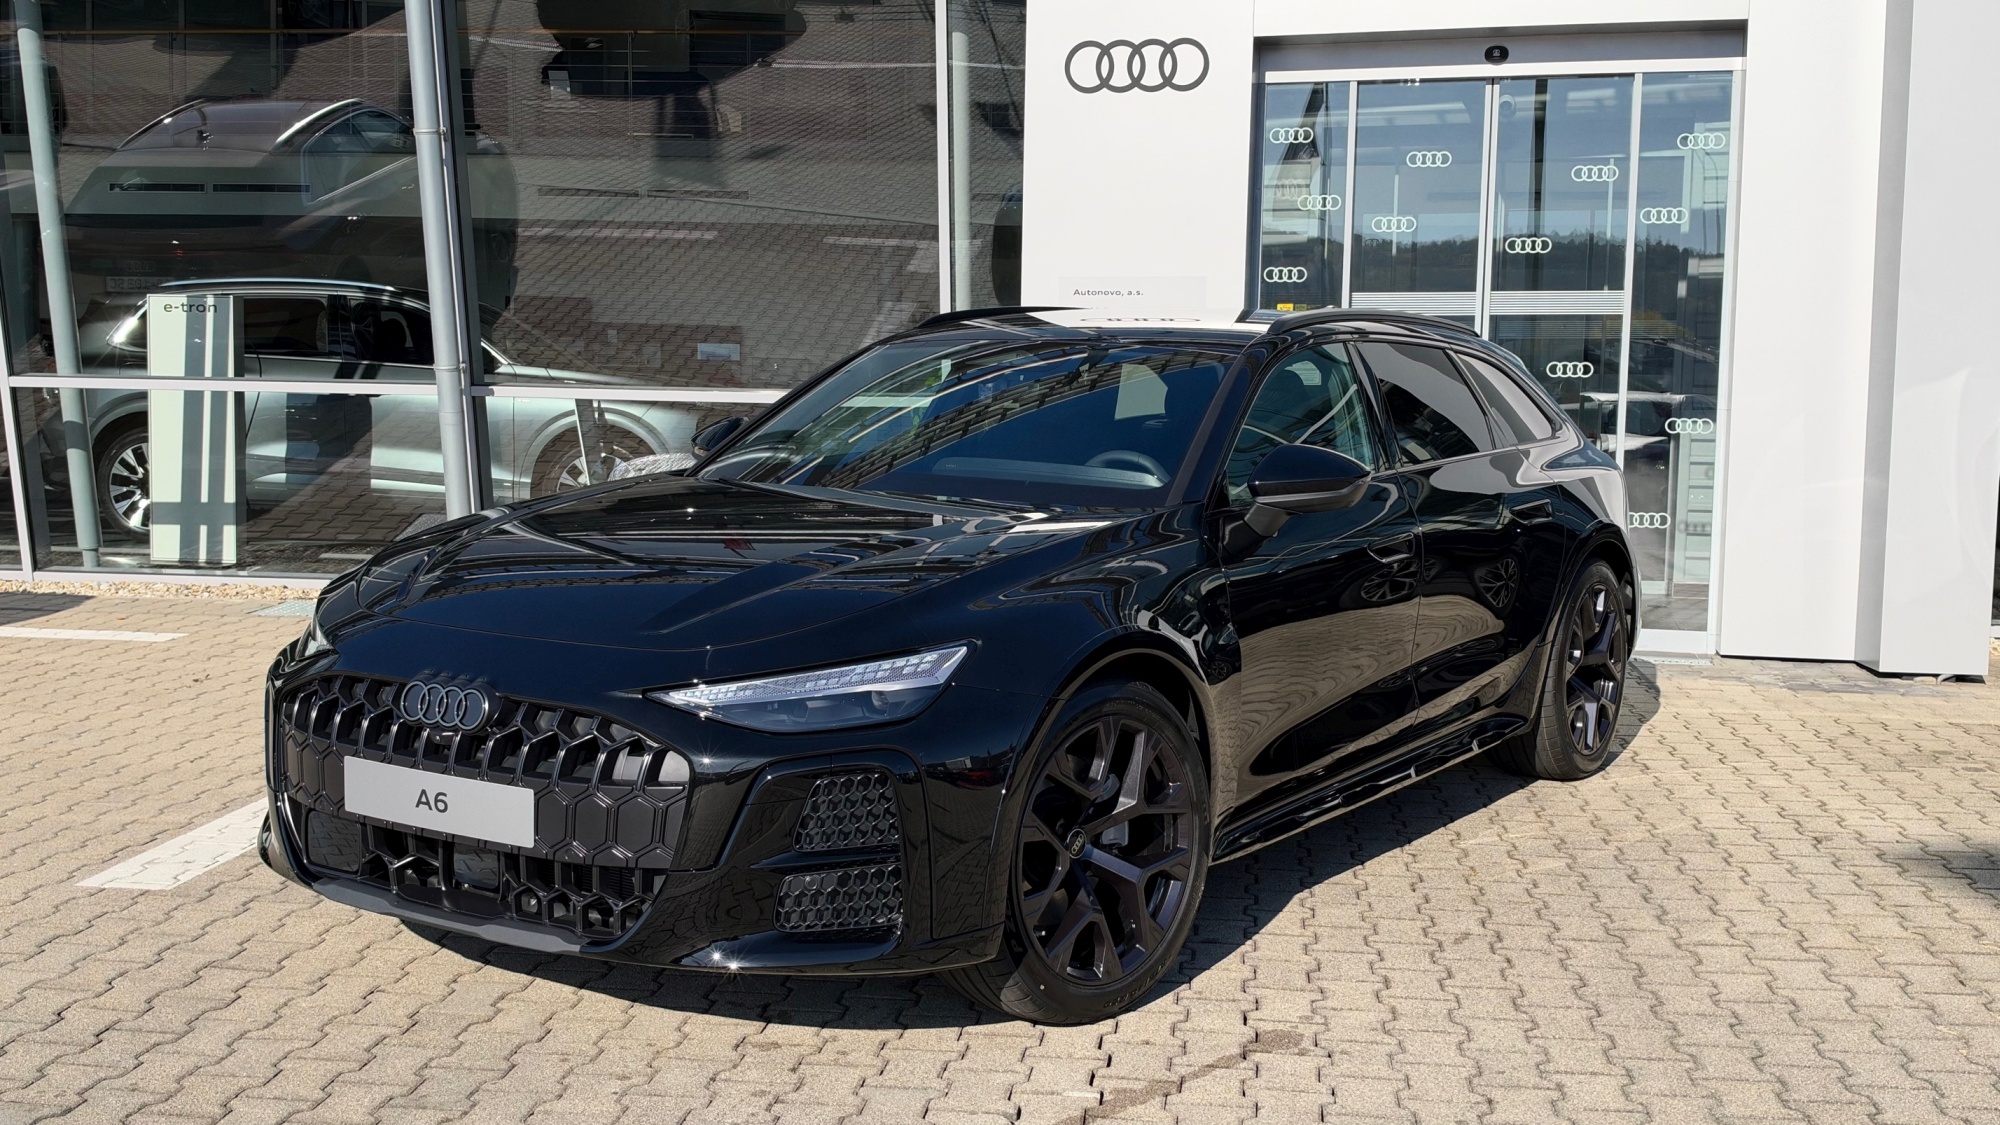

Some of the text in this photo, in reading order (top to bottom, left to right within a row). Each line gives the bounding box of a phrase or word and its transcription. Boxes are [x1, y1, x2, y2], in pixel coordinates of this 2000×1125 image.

[1073, 288, 1124, 297] Autonovo,
[163, 302, 218, 313] e-tron
[415, 788, 449, 814] A6
